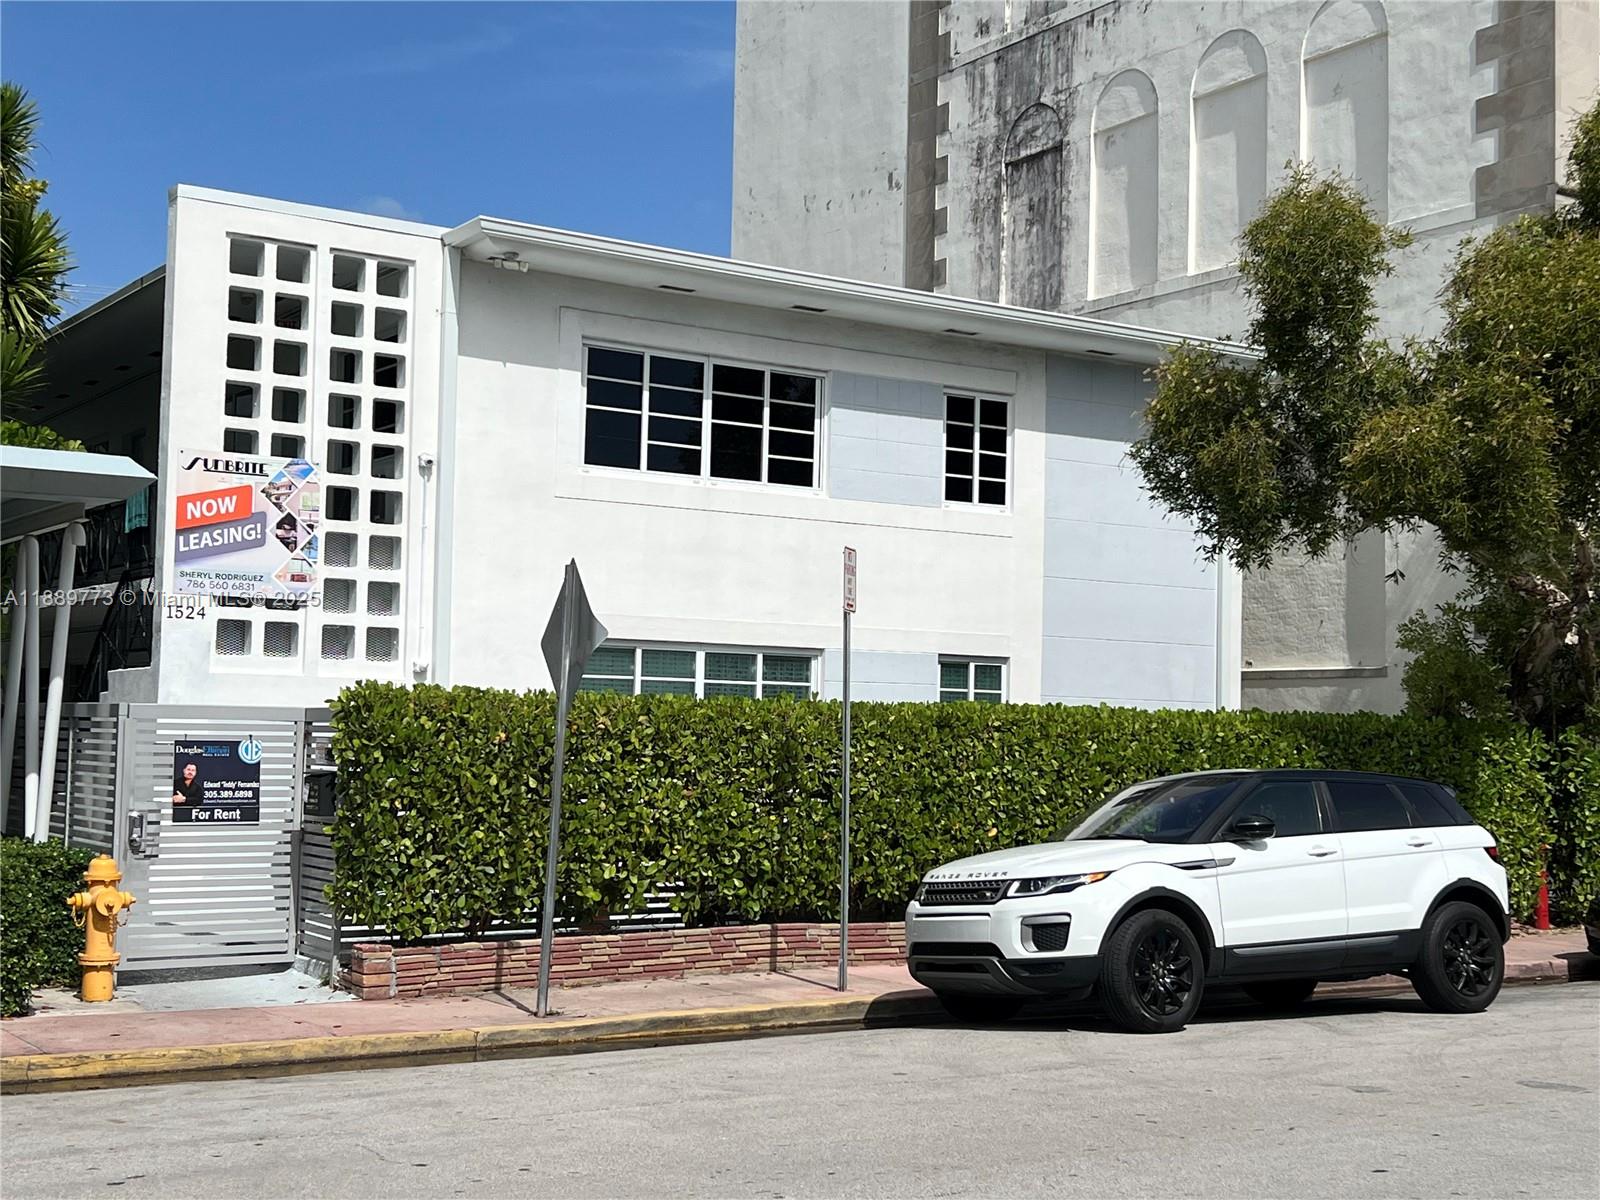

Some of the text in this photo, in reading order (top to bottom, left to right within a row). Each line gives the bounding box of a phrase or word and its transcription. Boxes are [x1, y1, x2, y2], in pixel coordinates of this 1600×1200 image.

[186, 495, 237, 520] NOW
[179, 523, 262, 552] LEASING!
[179, 570, 264, 582] SHERYL RODRIGUEZ
[186, 579, 255, 591] 786 560 6831
[166, 605, 206, 620] 1524
[191, 808, 241, 819] For Rent
